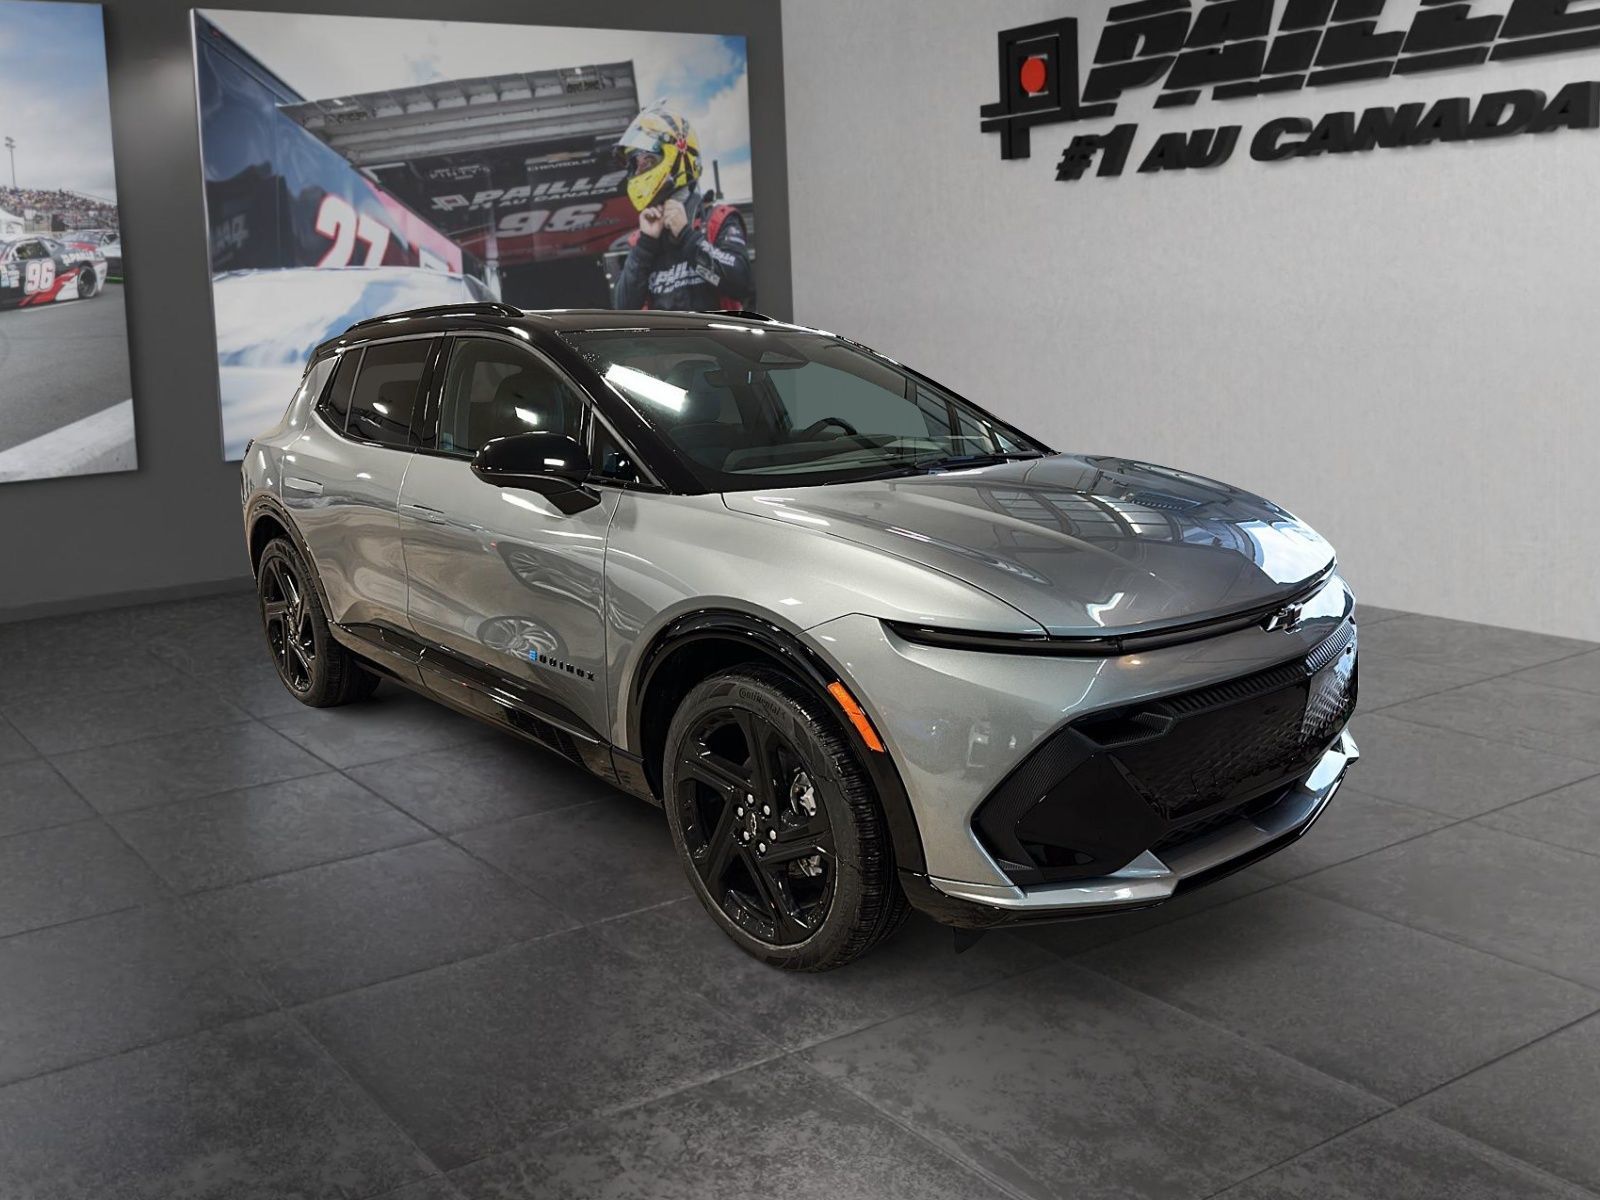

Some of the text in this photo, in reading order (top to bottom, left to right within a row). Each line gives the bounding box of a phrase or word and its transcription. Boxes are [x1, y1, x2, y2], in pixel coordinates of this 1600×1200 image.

[1055, 81, 1600, 181] #1 AU CANADA
[315, 194, 390, 269] 27
[495, 203, 603, 238] 96
[24, 259, 56, 295] 96
